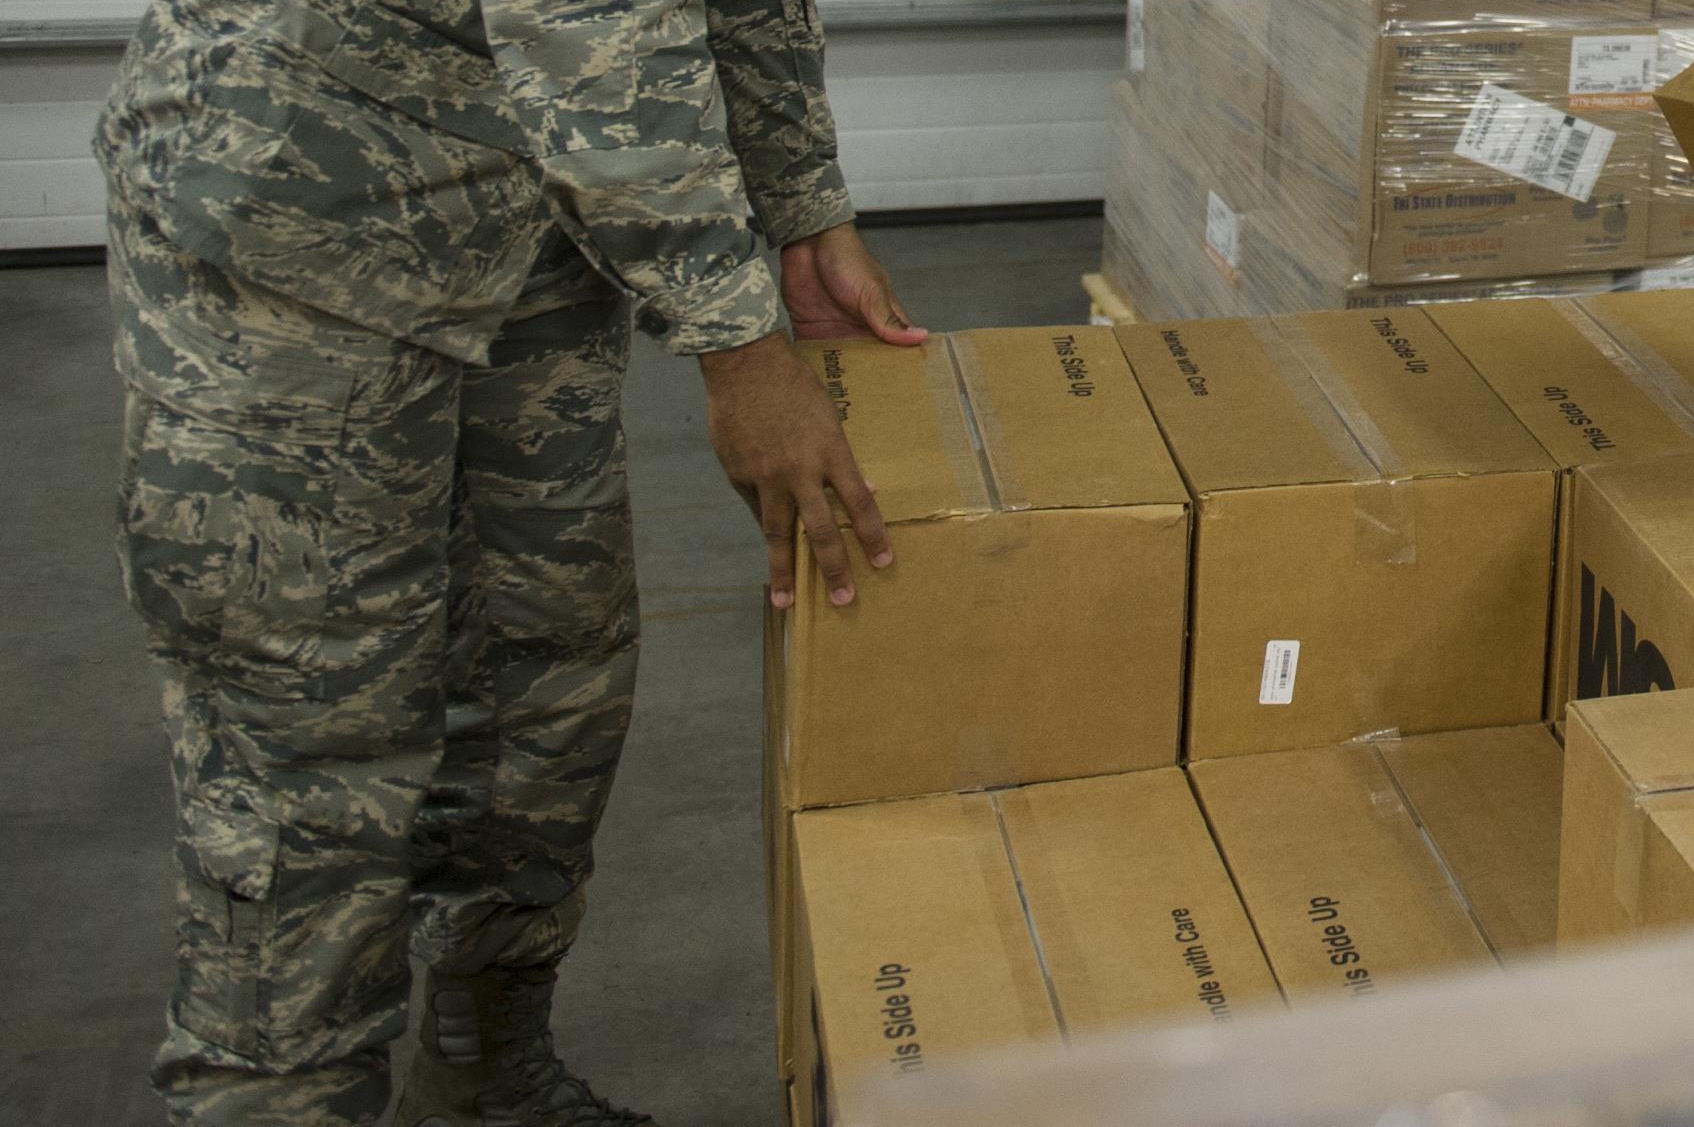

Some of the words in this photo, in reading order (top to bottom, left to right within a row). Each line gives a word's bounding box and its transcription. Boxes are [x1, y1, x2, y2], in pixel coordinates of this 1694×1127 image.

[1052, 334, 1080, 359] This
[1370, 317, 1397, 337] This
[1387, 337, 1416, 359] Side
[1405, 360, 1429, 374] Up
[822, 349, 842, 383] Handle
[1062, 356, 1086, 383] Side
[1161, 330, 1187, 358] Handle
[1174, 355, 1199, 377] with
[1187, 376, 1209, 397] Care
[1069, 381, 1095, 398] Up
[1544, 385, 1568, 401] Up
[1559, 402, 1592, 426] Side
[1583, 427, 1617, 452] This
[1171, 907, 1201, 943] Care
[1308, 895, 1340, 923] Up
[1182, 940, 1216, 979] with
[1321, 923, 1362, 968] Side
[874, 962, 912, 992] Up
[1343, 968, 1377, 999] his
[883, 991, 917, 1041] Side
[1199, 980, 1235, 1026] andle
[891, 1041, 925, 1081] his
